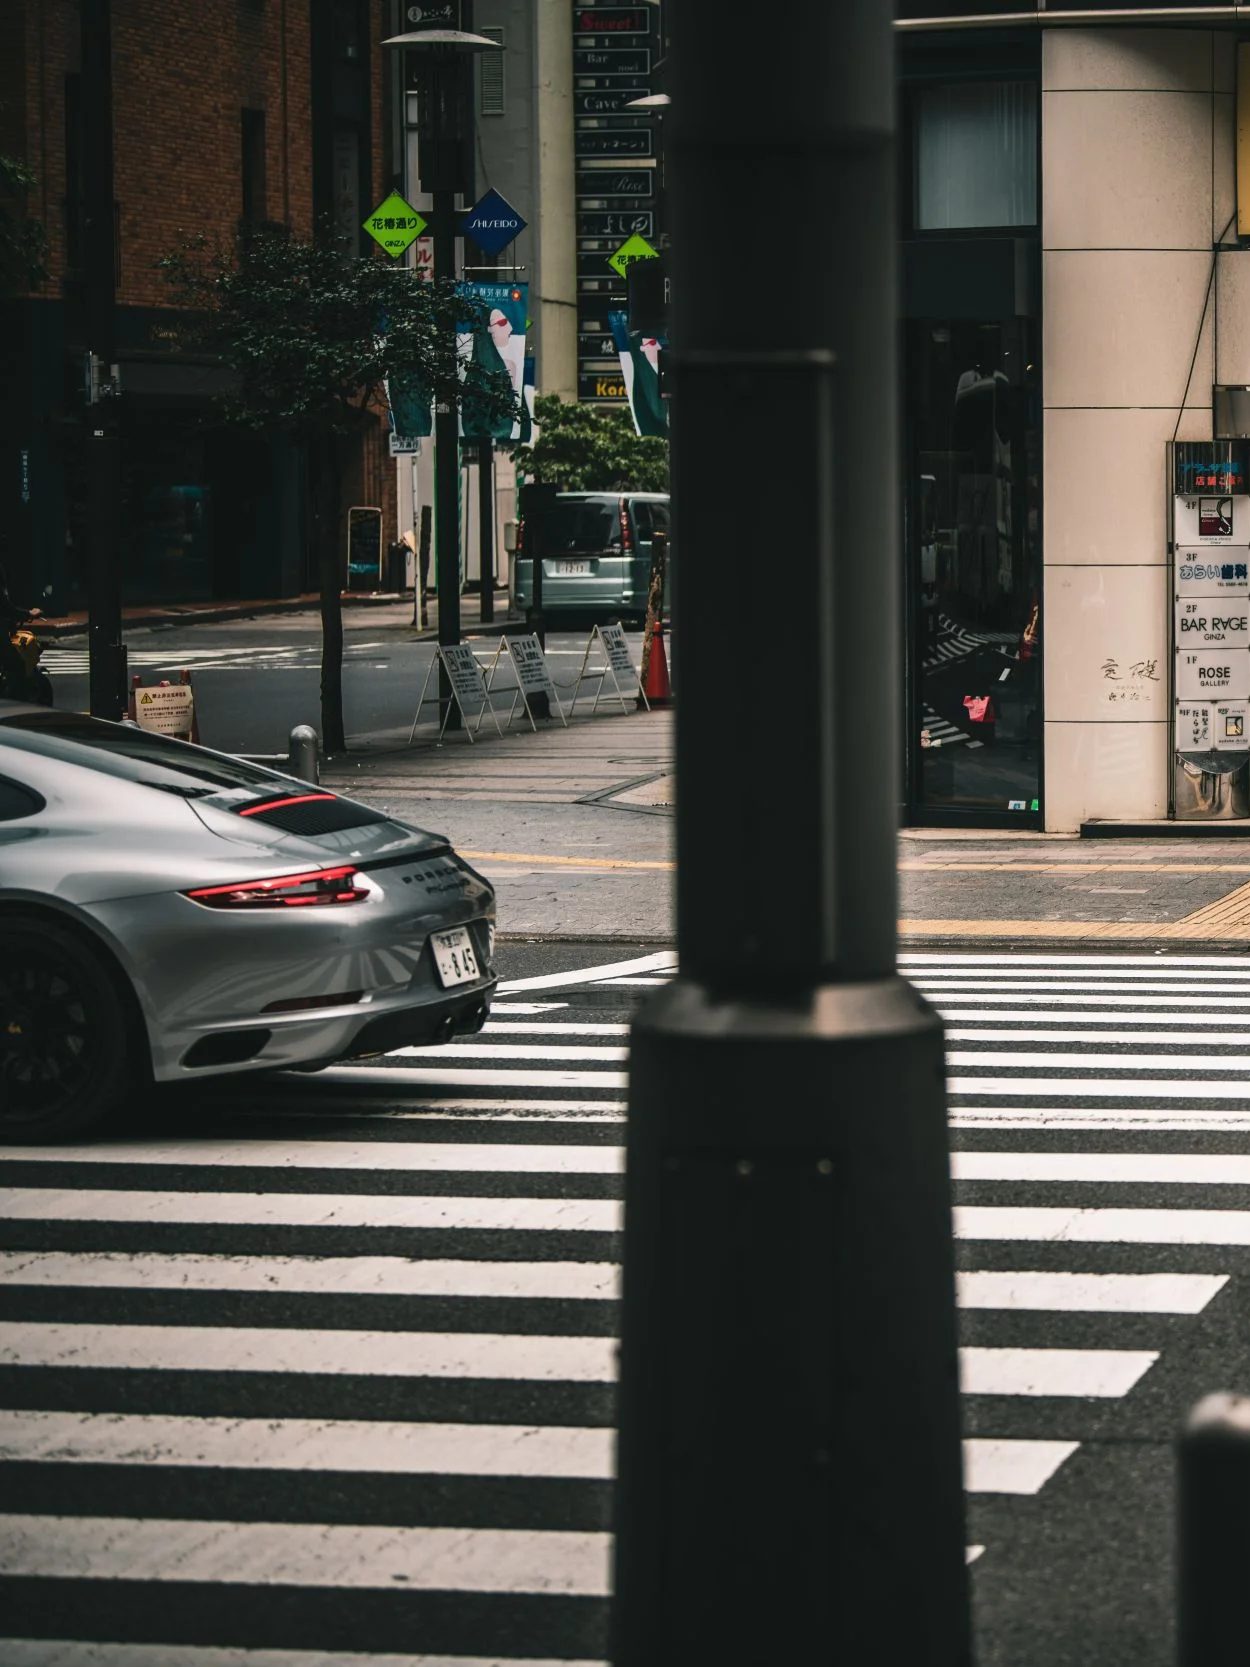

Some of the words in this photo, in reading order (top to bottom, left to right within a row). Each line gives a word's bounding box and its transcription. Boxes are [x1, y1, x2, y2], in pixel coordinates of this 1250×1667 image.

[372, 217, 417, 230] 花椿通り
[470, 218, 517, 229] SHISEIDO
[384, 240, 405, 248] GINZA
[1185, 501, 1197, 510] 4F
[1186, 553, 1198, 561] 3F
[1180, 563, 1248, 580] あらい歯科
[1186, 605, 1198, 613] 2F
[1181, 617, 1207, 632] BAR
[1203, 633, 1226, 641] GINZA
[1186, 656, 1198, 664] 1F
[1199, 667, 1231, 679] ROSE
